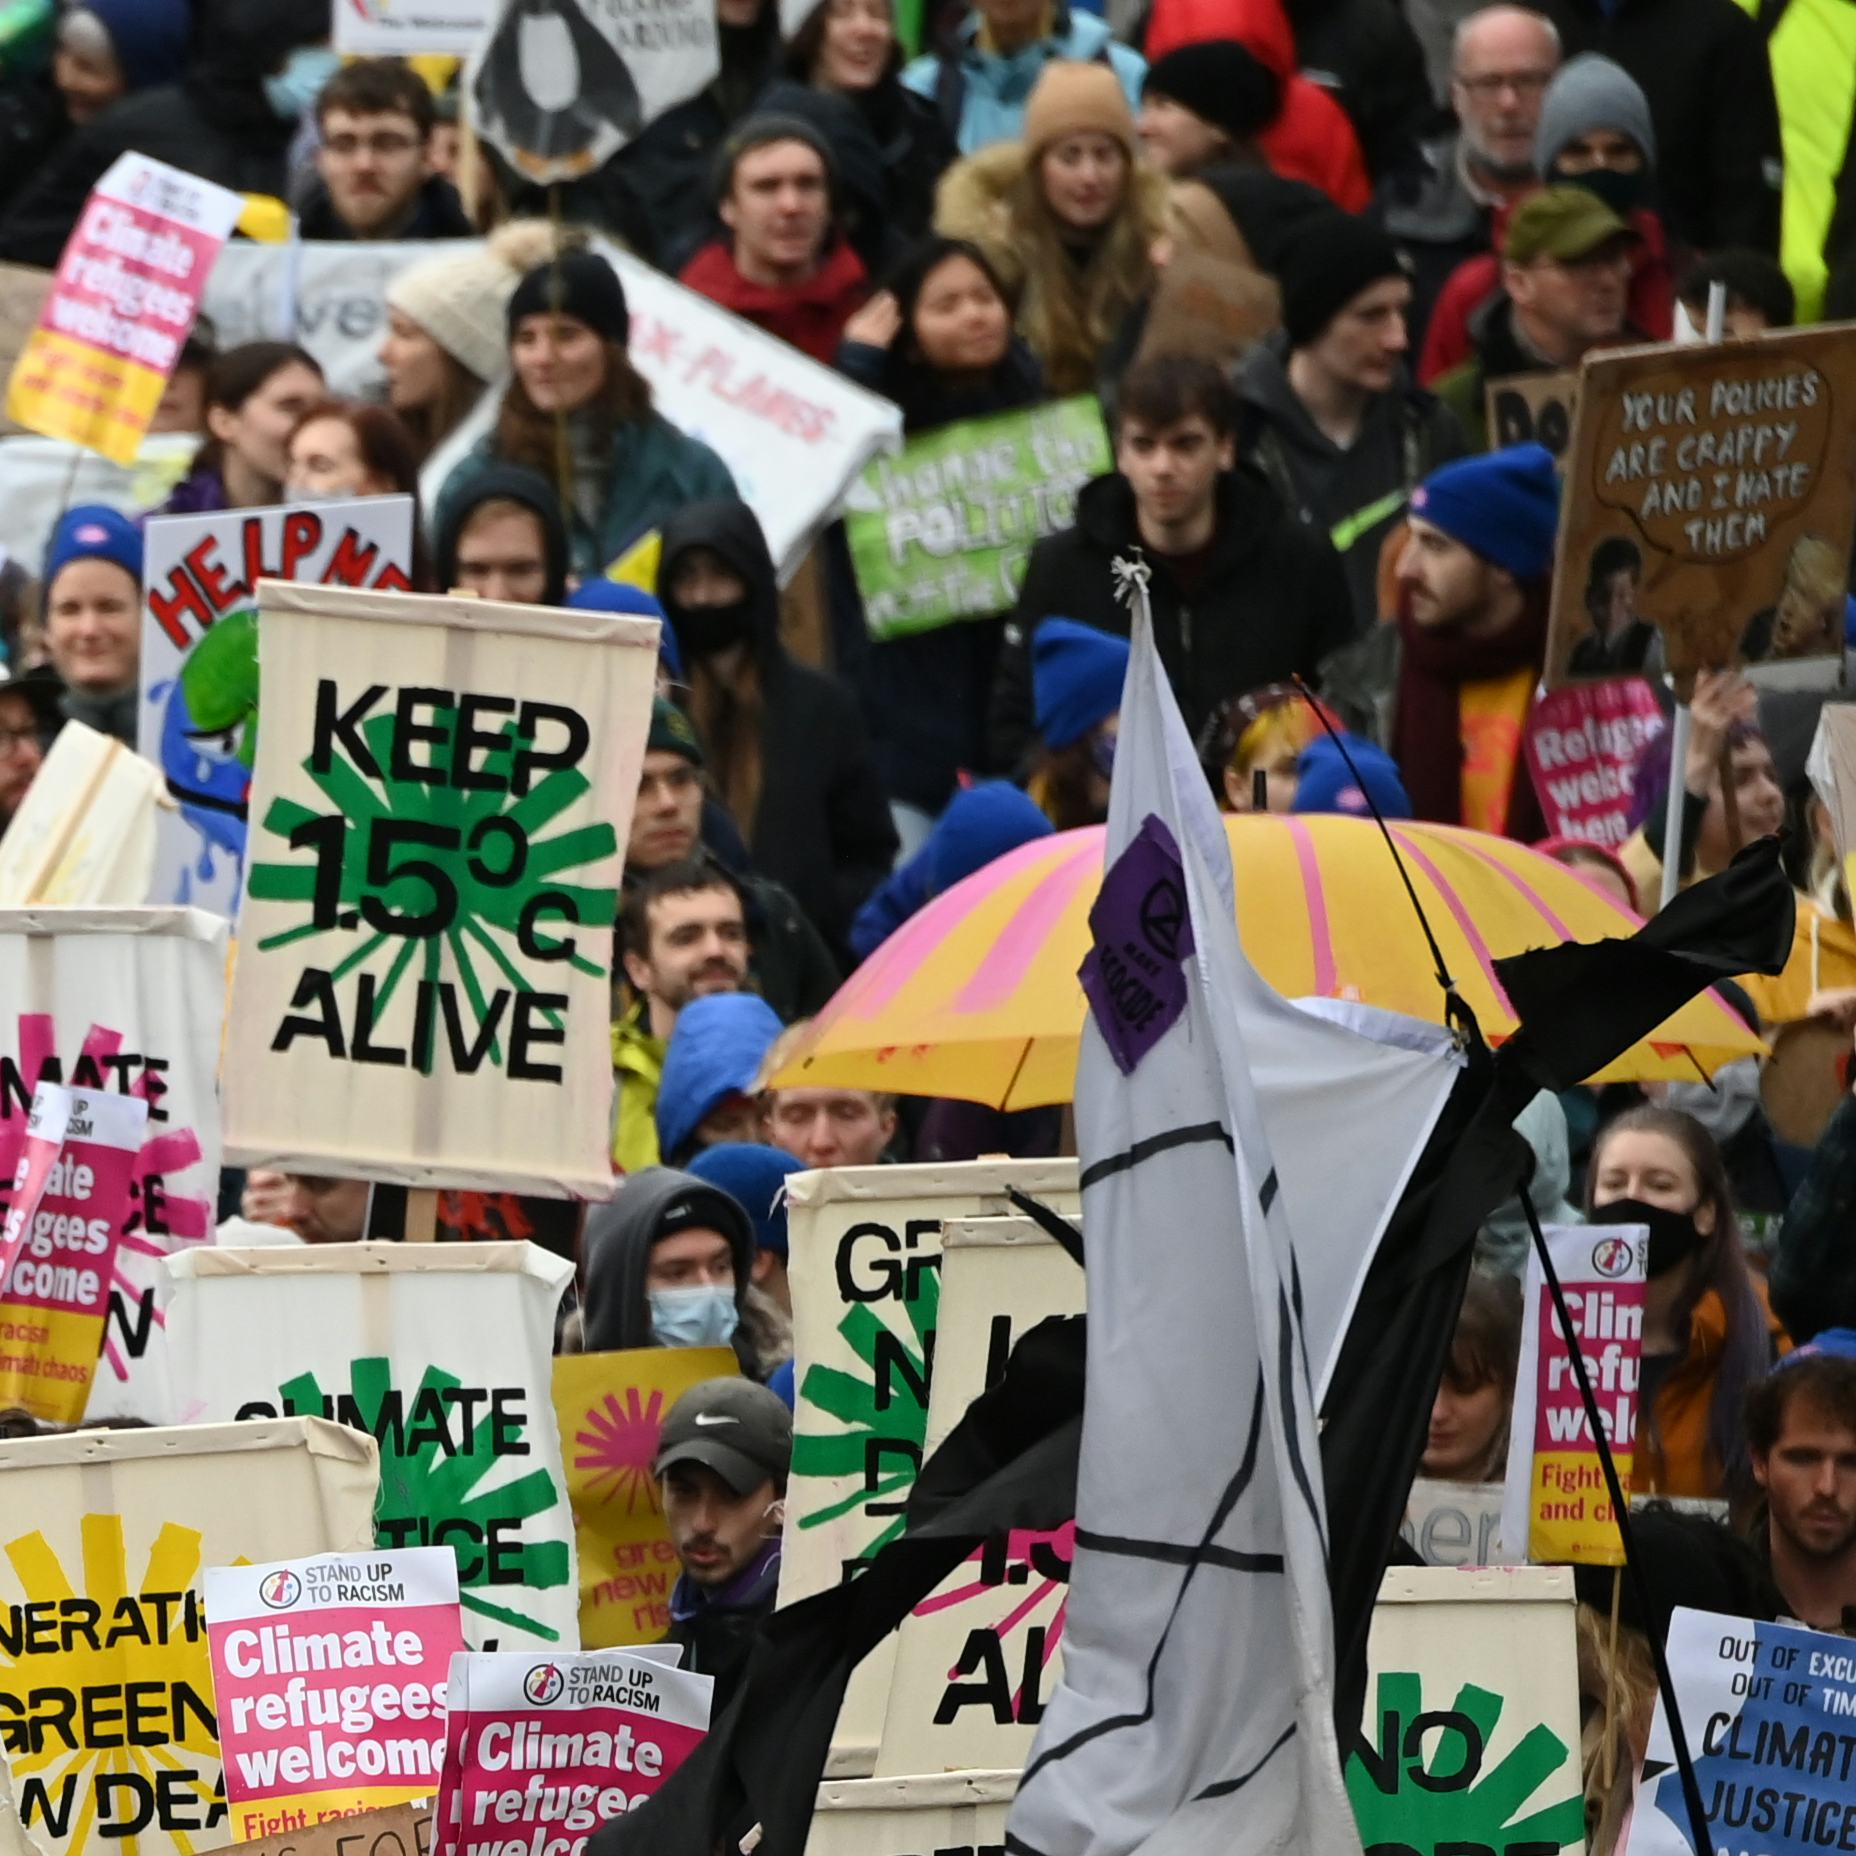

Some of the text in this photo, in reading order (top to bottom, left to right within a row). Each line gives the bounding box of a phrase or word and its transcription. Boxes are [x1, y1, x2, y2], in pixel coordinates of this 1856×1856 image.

[84, 202, 194, 279] Climate
[66, 254, 193, 326] refugees
[52, 294, 177, 369] welcome
[1622, 385, 1697, 434] YOUR
[1709, 370, 1818, 419] POLICIES
[1606, 423, 1797, 485] ARE CRAPPY
[1641, 462, 1811, 522] AND I HATE
[1686, 514, 1768, 553] THEM
[149, 510, 322, 650] HELP
[310, 677, 590, 797] KEEP
[271, 968, 571, 1084] ALIVE
[306, 1564, 392, 1583] STAND UP
[307, 1584, 404, 1603] TO RACISM
[593, 1572, 667, 1608] new
[224, 1620, 424, 1679] Climate
[569, 1664, 653, 1688] STAND UP
[1719, 1635, 1800, 1671] OUT OF
[230, 1677, 448, 1734] refugees
[568, 1686, 660, 1712] TO RACISM
[1731, 1673, 1812, 1707] OUT OF
[478, 1721, 663, 1777] Climate
